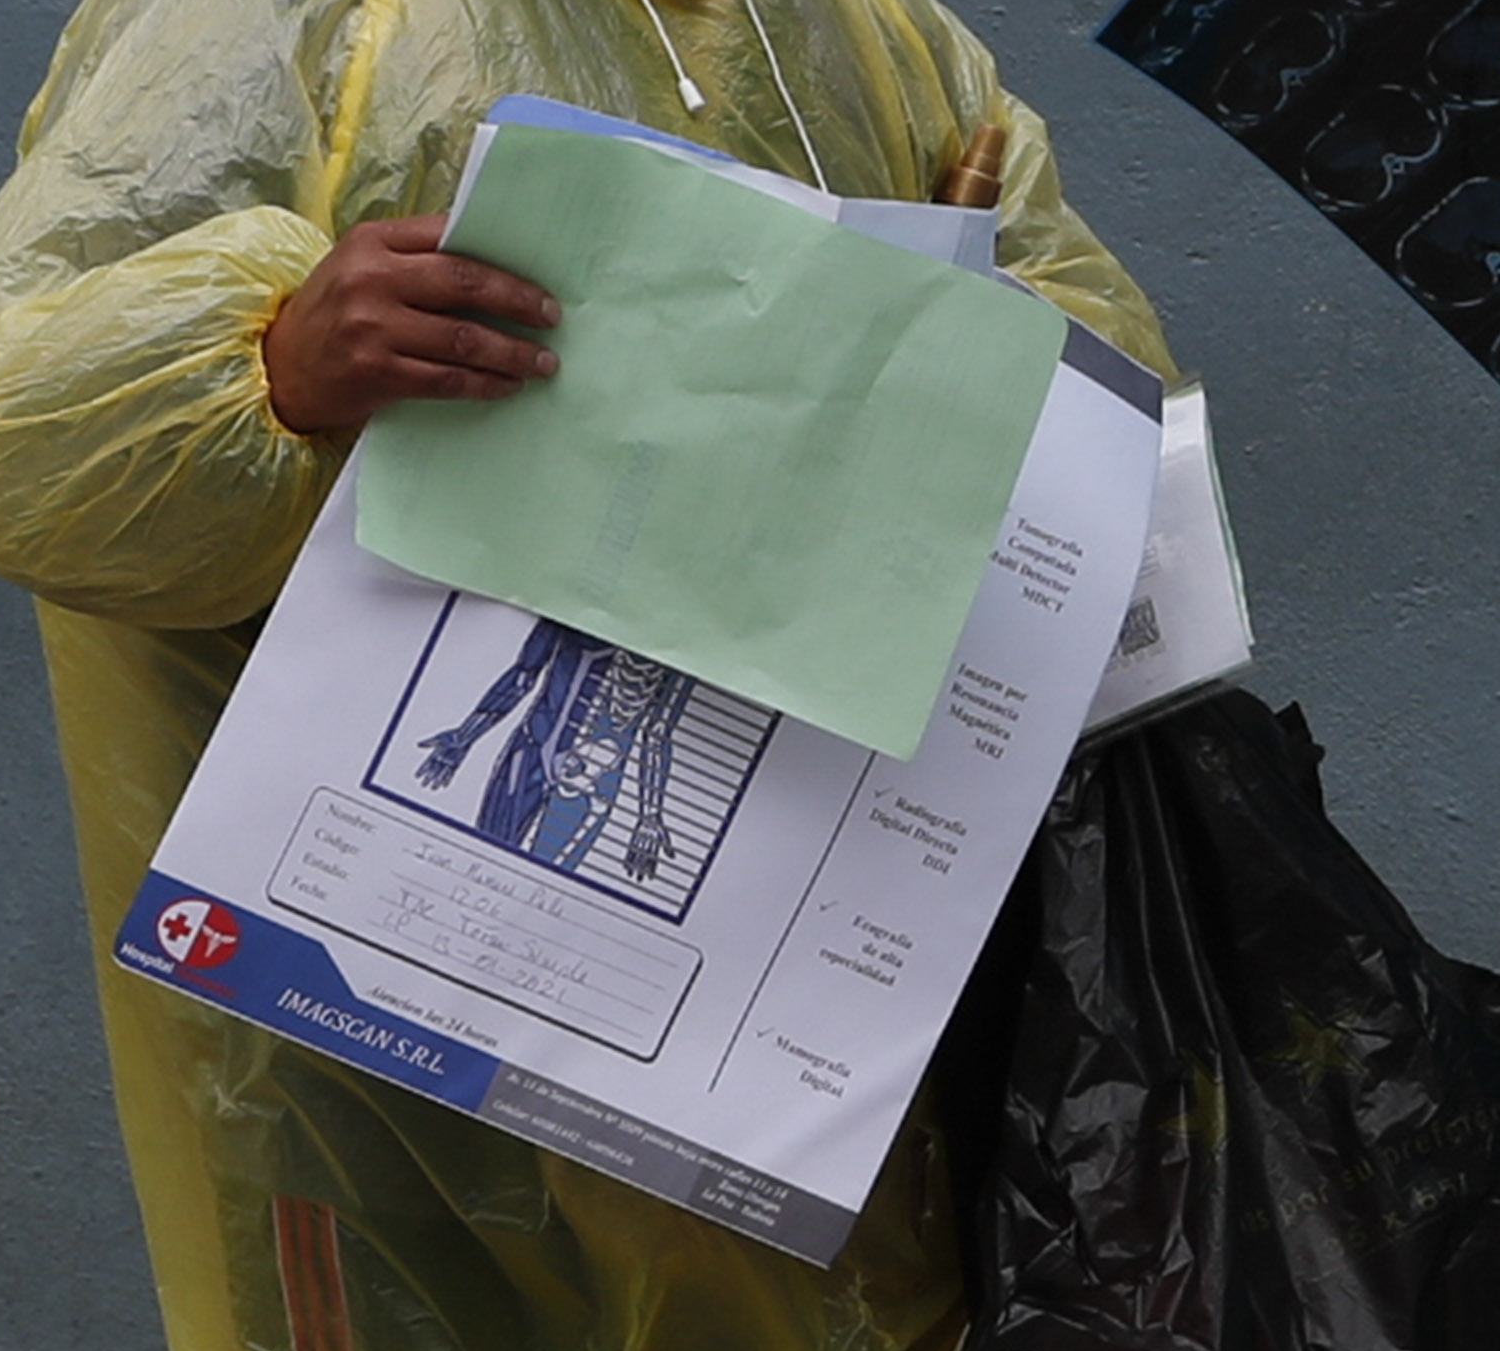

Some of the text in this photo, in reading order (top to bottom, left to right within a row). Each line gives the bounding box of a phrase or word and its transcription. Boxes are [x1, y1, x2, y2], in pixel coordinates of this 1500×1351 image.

[1004, 534, 1080, 579] Computada
[1018, 562, 1072, 596] Detector
[1018, 584, 1065, 616] MDCT
[948, 680, 1022, 723] Resonancia
[956, 661, 1028, 707] Imagen por
[867, 806, 913, 838] Digital
[816, 944, 896, 990] especialidad
[878, 948, 906, 969] alta
[275, 984, 451, 1078] IMAGSCAN S.R.L.
[797, 1068, 846, 1100] Digital
